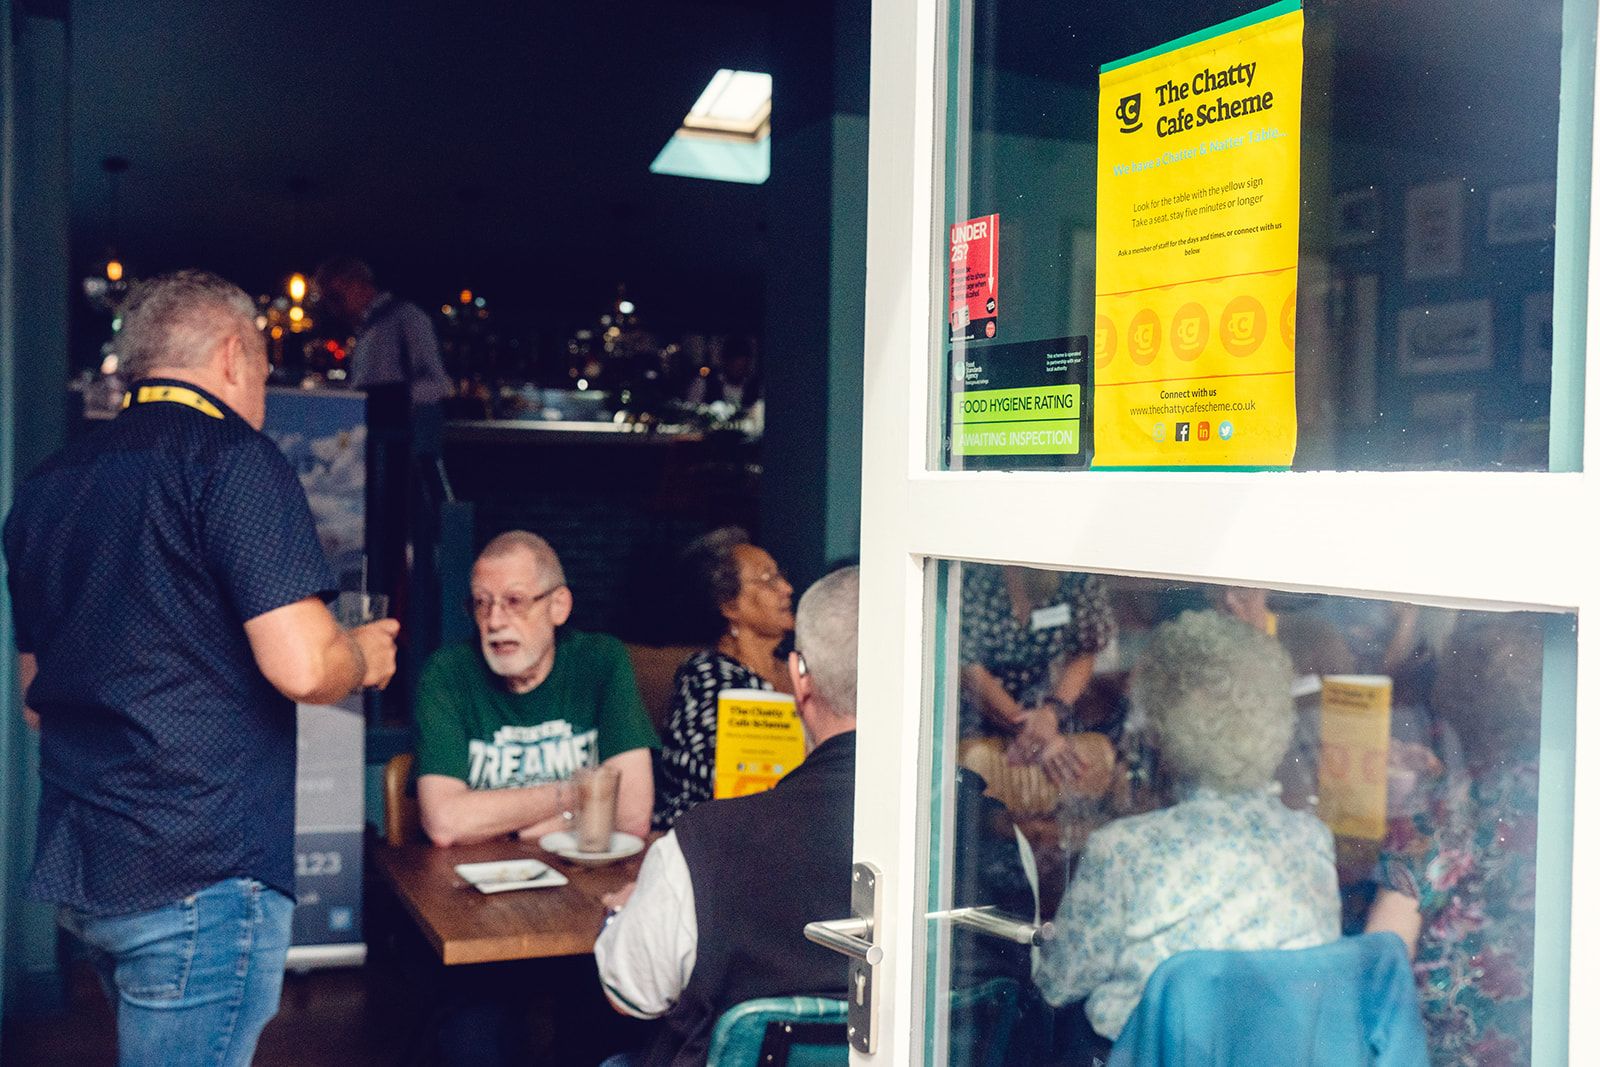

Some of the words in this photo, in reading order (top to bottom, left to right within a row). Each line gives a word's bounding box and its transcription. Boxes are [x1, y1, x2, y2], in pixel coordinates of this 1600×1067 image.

[1155, 80, 1189, 107] The
[1192, 62, 1256, 95] Chatty
[1156, 108, 1194, 138] Cafe
[1196, 91, 1274, 127] Scheme
[1113, 164, 1129, 176] We
[1131, 159, 1154, 173] have
[1155, 158, 1161, 167] a
[1161, 147, 1197, 165] Chatter
[1199, 142, 1207, 155] &
[1210, 135, 1245, 153] Natter
[1133, 201, 1149, 213] Look
[1150, 199, 1160, 209] for
[1161, 197, 1172, 207] the
[1173, 192, 1191, 204] table
[1191, 188, 1207, 200] with
[1208, 186, 1220, 196] the
[1221, 181, 1246, 195] yellow
[1246, 177, 1264, 189] sign
[1131, 218, 1148, 228] Take
[1149, 217, 1153, 225] a
[1169, 211, 1185, 221] stay
[1185, 207, 1198, 217] five
[1198, 201, 1226, 214] minutes
[1227, 199, 1236, 208] or
[1237, 194, 1264, 206] longer
[952, 221, 987, 244] UNDER
[1132, 246, 1152, 254] member
[1158, 241, 1169, 249] staff
[1177, 238, 1187, 246] the
[1187, 236, 1199, 244] days
[1199, 233, 1210, 242] and
[1210, 232, 1226, 240] times,
[1233, 226, 1259, 236] connect
[1260, 223, 1274, 232] with
[951, 243, 969, 262] 25?
[1184, 248, 1200, 256] below
[960, 399, 988, 413] FOOD
[990, 396, 1032, 412] HYGIENE
[1034, 394, 1073, 410] RATING
[1160, 390, 1190, 400] Connect
[1191, 388, 1208, 398] with
[1208, 387, 1217, 397] us
[1130, 400, 1256, 416] www.thechattycafescheme.co.uk
[960, 432, 1007, 447] AWAITING
[1009, 430, 1073, 446] INSPECTION
